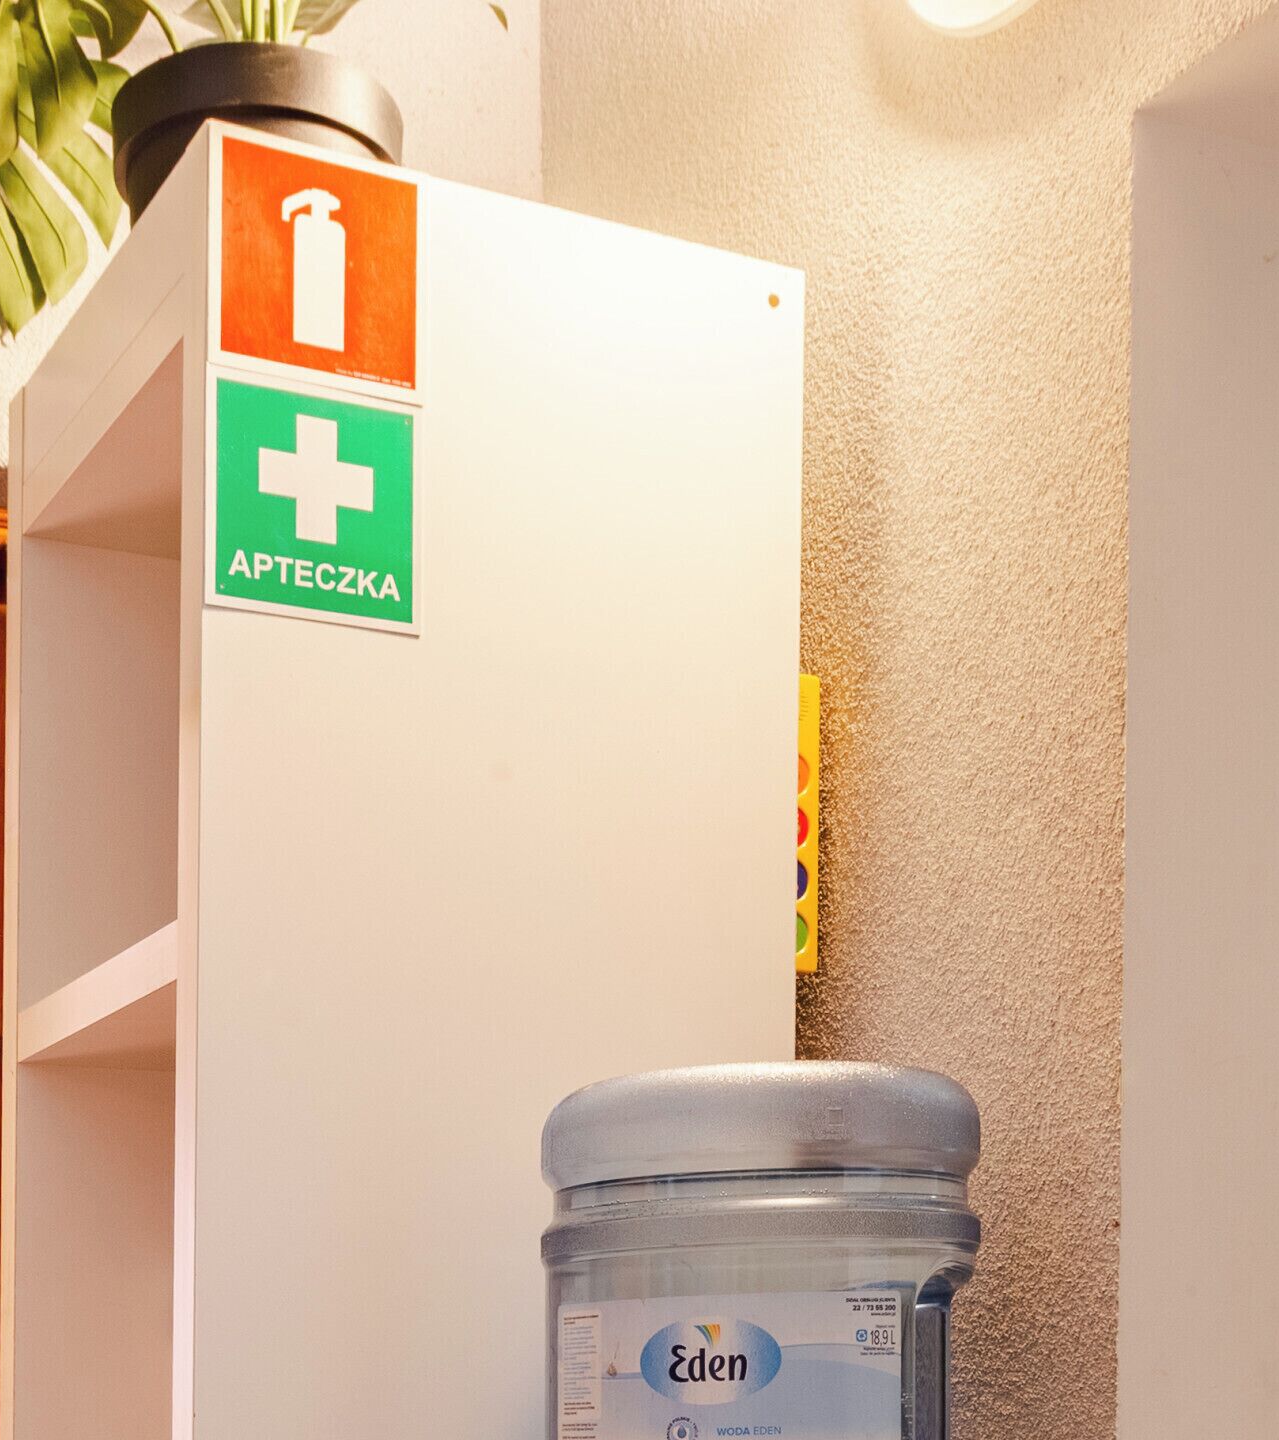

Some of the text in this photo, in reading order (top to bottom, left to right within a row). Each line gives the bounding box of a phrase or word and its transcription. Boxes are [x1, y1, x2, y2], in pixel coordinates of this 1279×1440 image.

[228, 549, 401, 602] APTECZKA
[870, 1329, 896, 1347] 18,9 L
[668, 1344, 748, 1383] Eden
[716, 1426, 782, 1436] WODA EDEN
